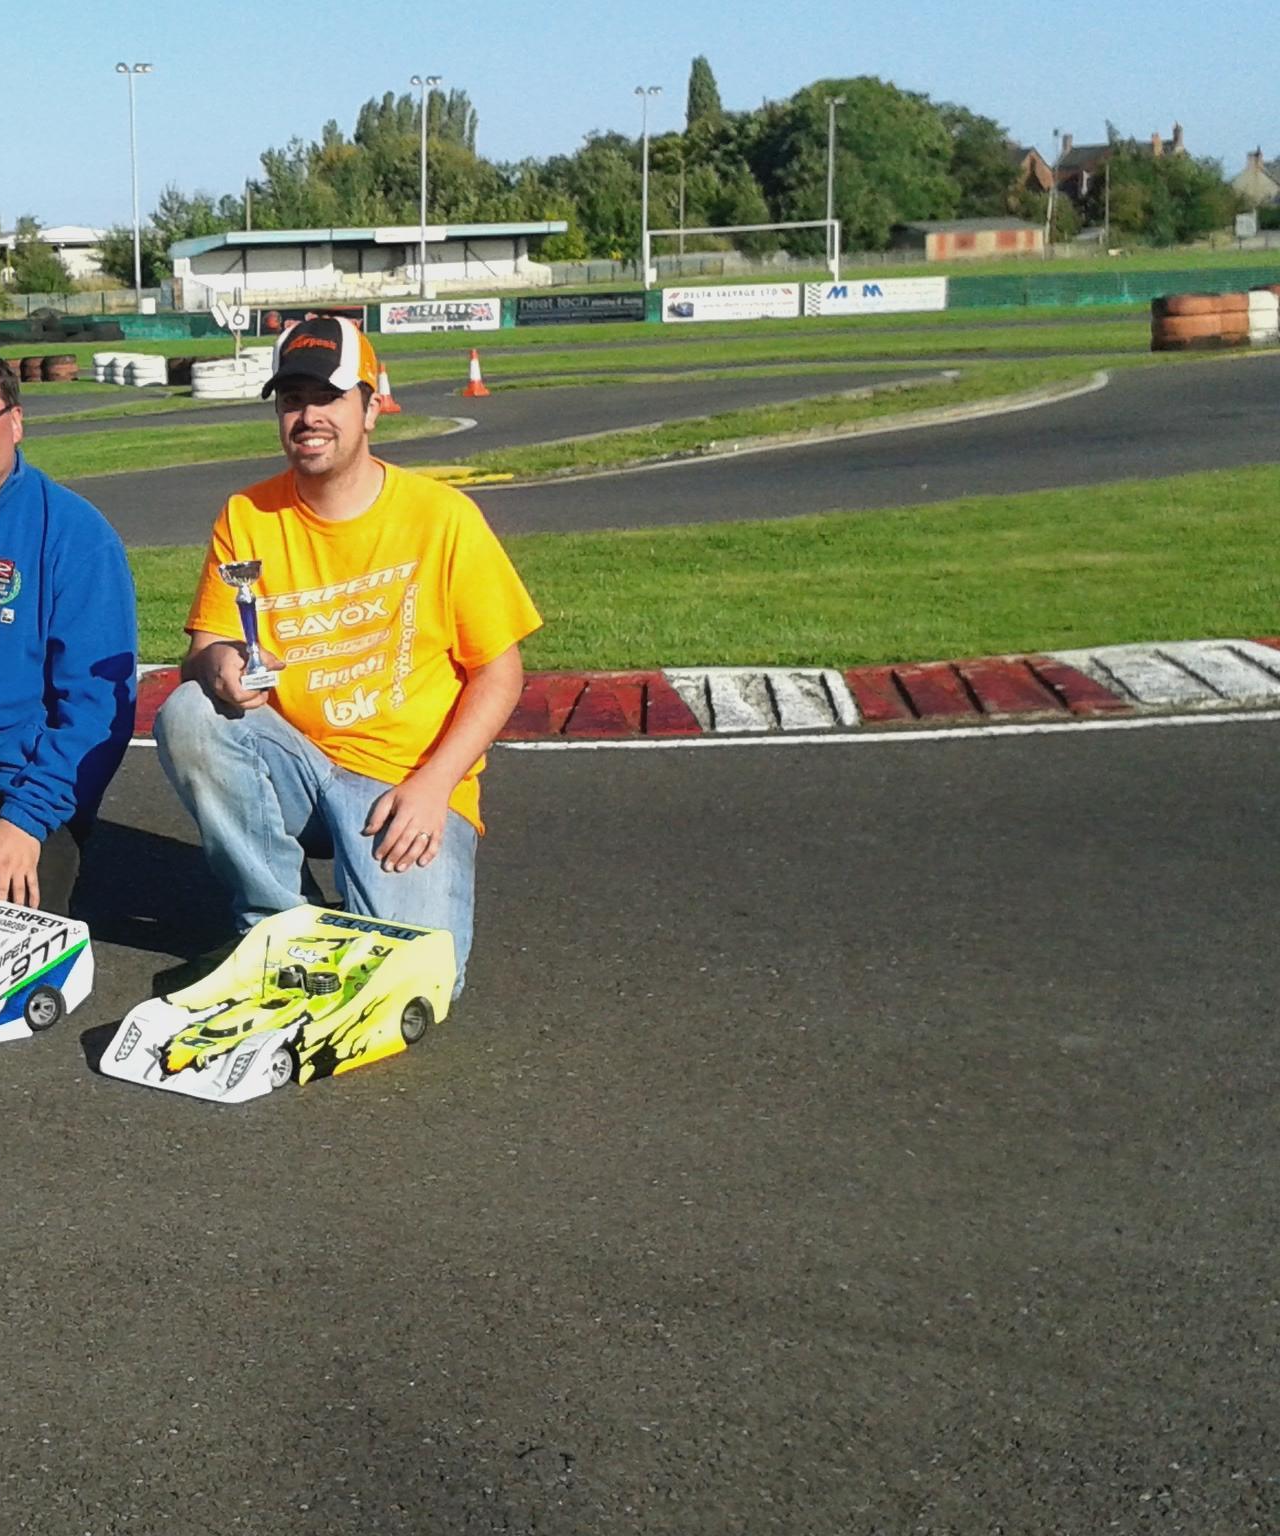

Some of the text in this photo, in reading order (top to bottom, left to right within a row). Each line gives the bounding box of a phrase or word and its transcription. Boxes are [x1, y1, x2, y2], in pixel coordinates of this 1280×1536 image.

[232, 306, 245, 326] 6
[317, 913, 426, 941] SERPEN
[10, 928, 69, 986] 977
